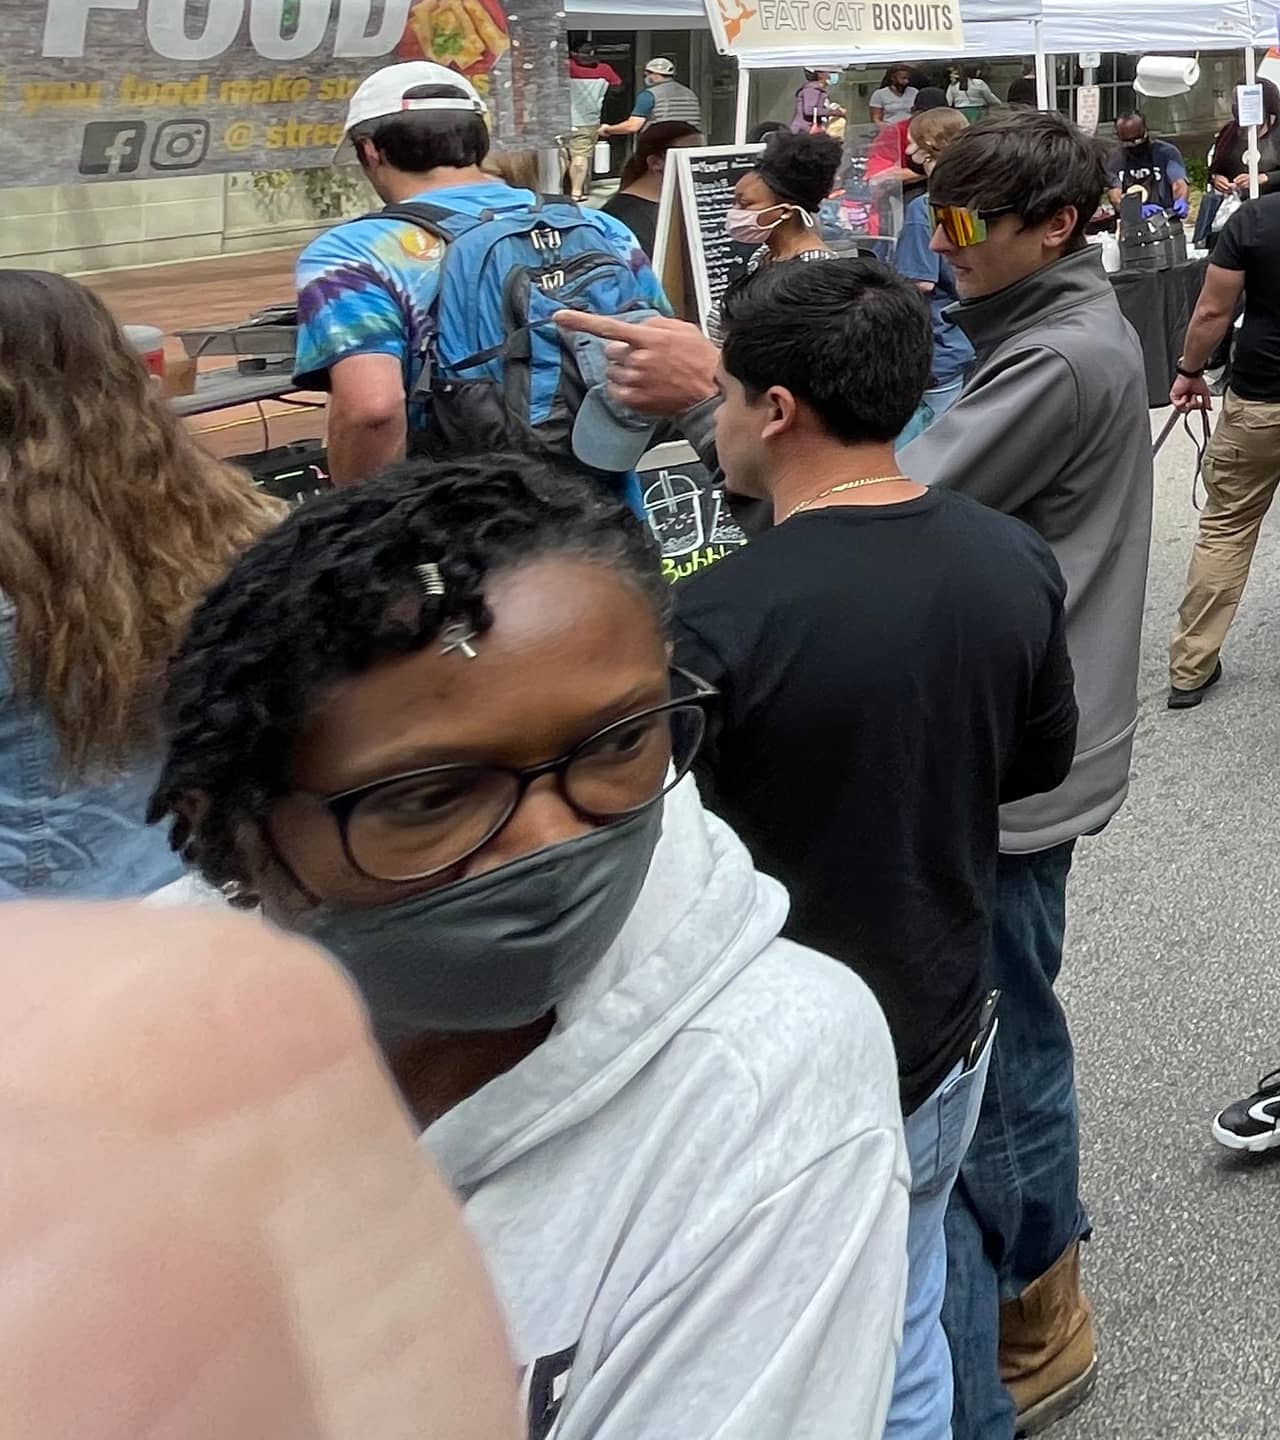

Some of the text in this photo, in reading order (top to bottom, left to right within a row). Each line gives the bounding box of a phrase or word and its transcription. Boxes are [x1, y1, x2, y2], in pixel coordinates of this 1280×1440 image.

[758, 0, 953, 32] FAT CAT BISCUITS
[218, 75, 312, 105] make
